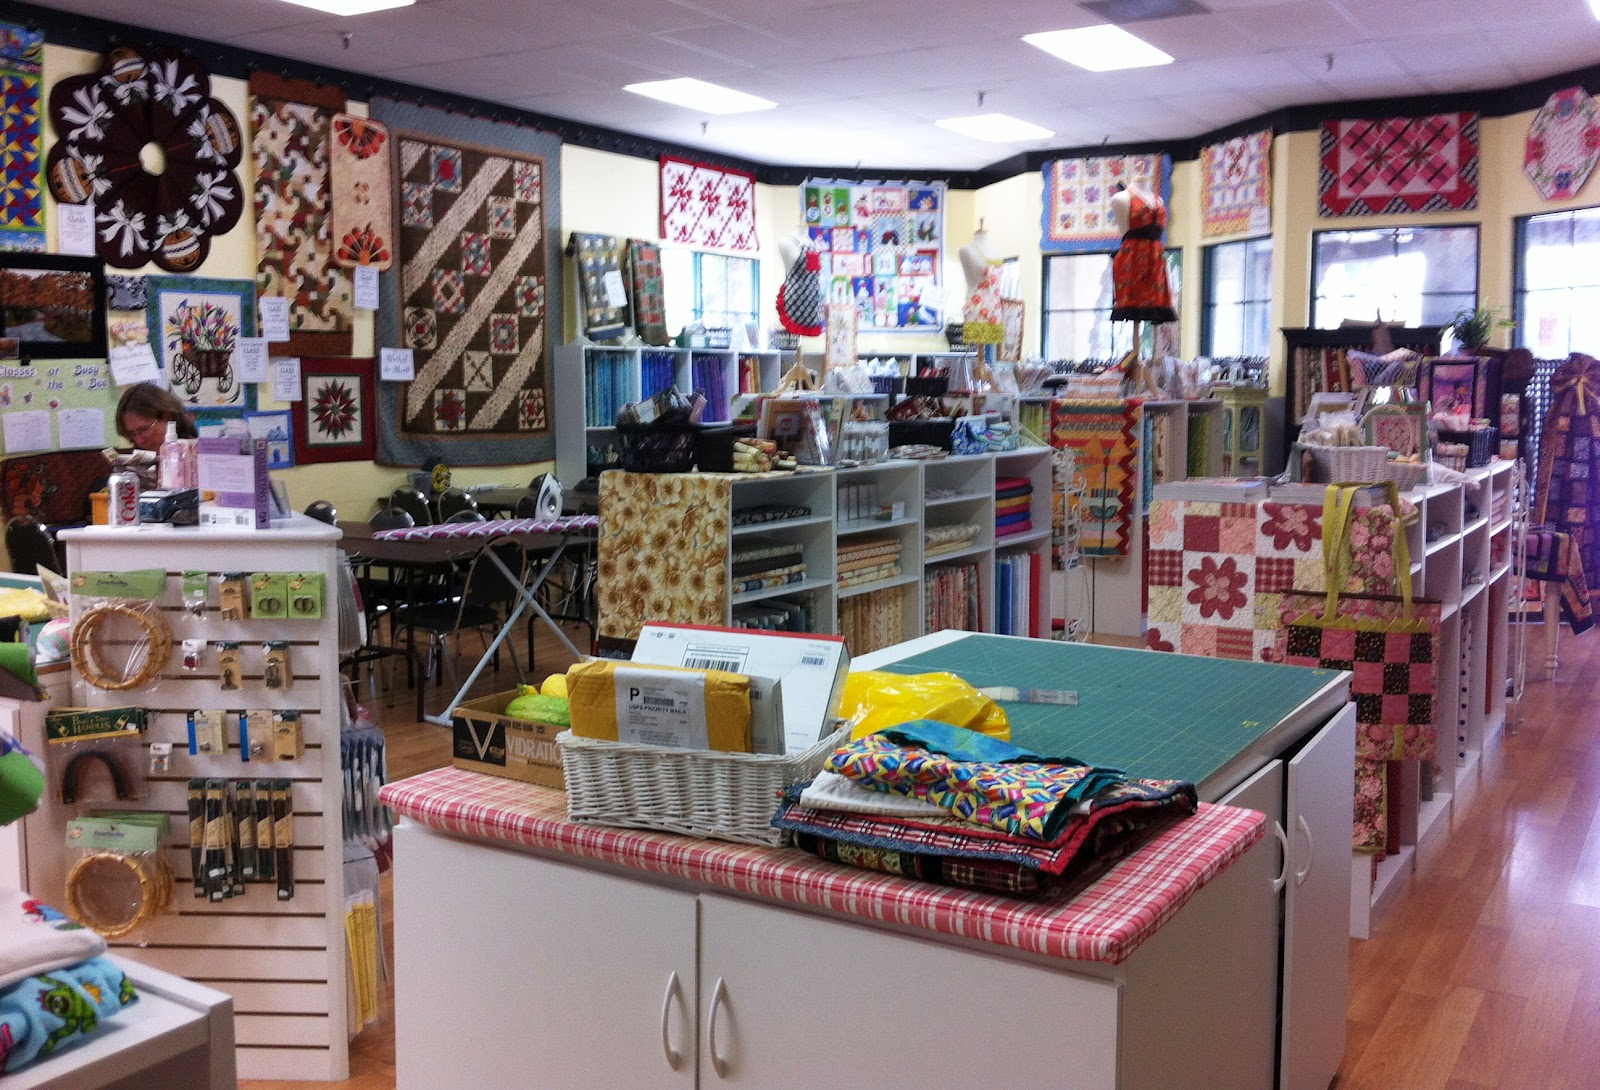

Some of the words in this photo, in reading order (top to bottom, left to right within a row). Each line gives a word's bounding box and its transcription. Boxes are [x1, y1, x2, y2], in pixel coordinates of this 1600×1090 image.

[0, 366, 35, 376] Classes
[48, 367, 59, 375] at
[74, 365, 98, 376] Busy
[48, 380, 63, 389] the
[88, 378, 108, 389] Bee
[120, 482, 136, 522] Coke
[630, 688, 640, 701] P
[629, 703, 643, 711] USPS
[644, 705, 669, 713] PRIORITY
